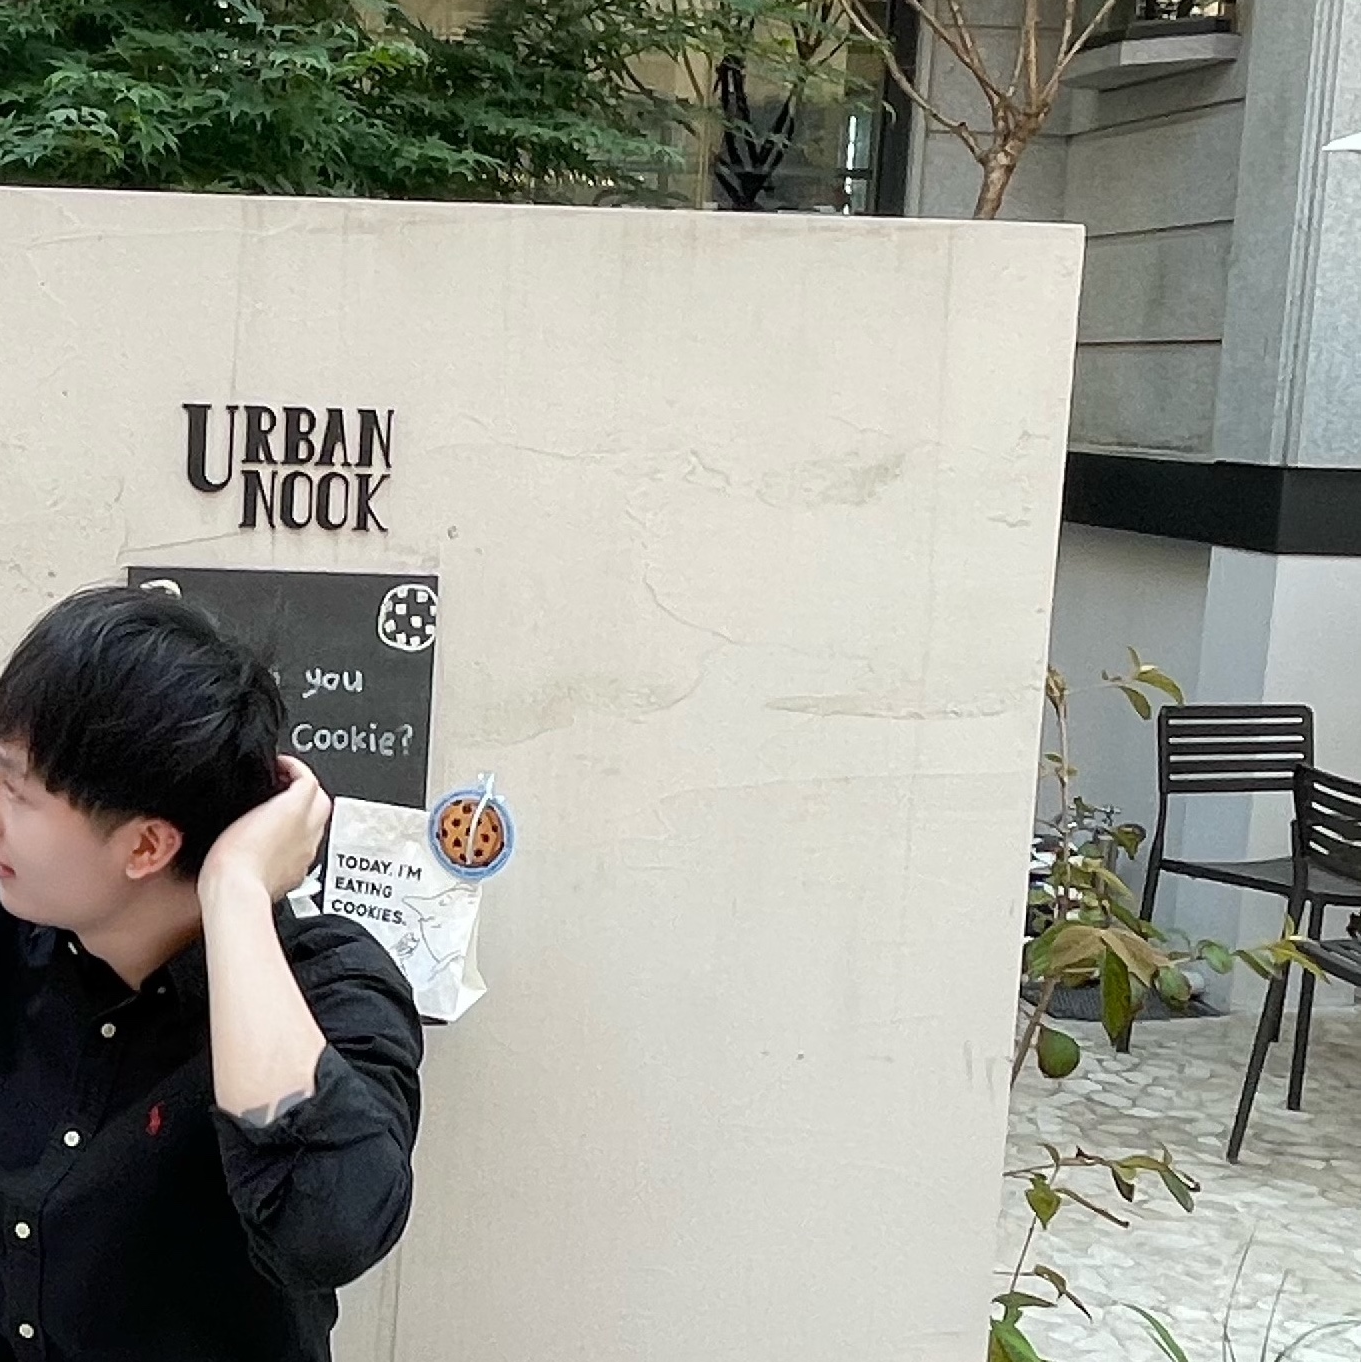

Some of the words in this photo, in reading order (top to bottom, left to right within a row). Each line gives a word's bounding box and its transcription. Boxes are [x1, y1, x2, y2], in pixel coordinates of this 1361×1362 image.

[182, 403, 394, 492] URBAN
[238, 469, 390, 532] NOOK
[302, 668, 363, 698] you
[291, 722, 413, 756] Cookie?
[335, 876, 393, 898] EATING
[331, 899, 406, 927] COOKIES.
